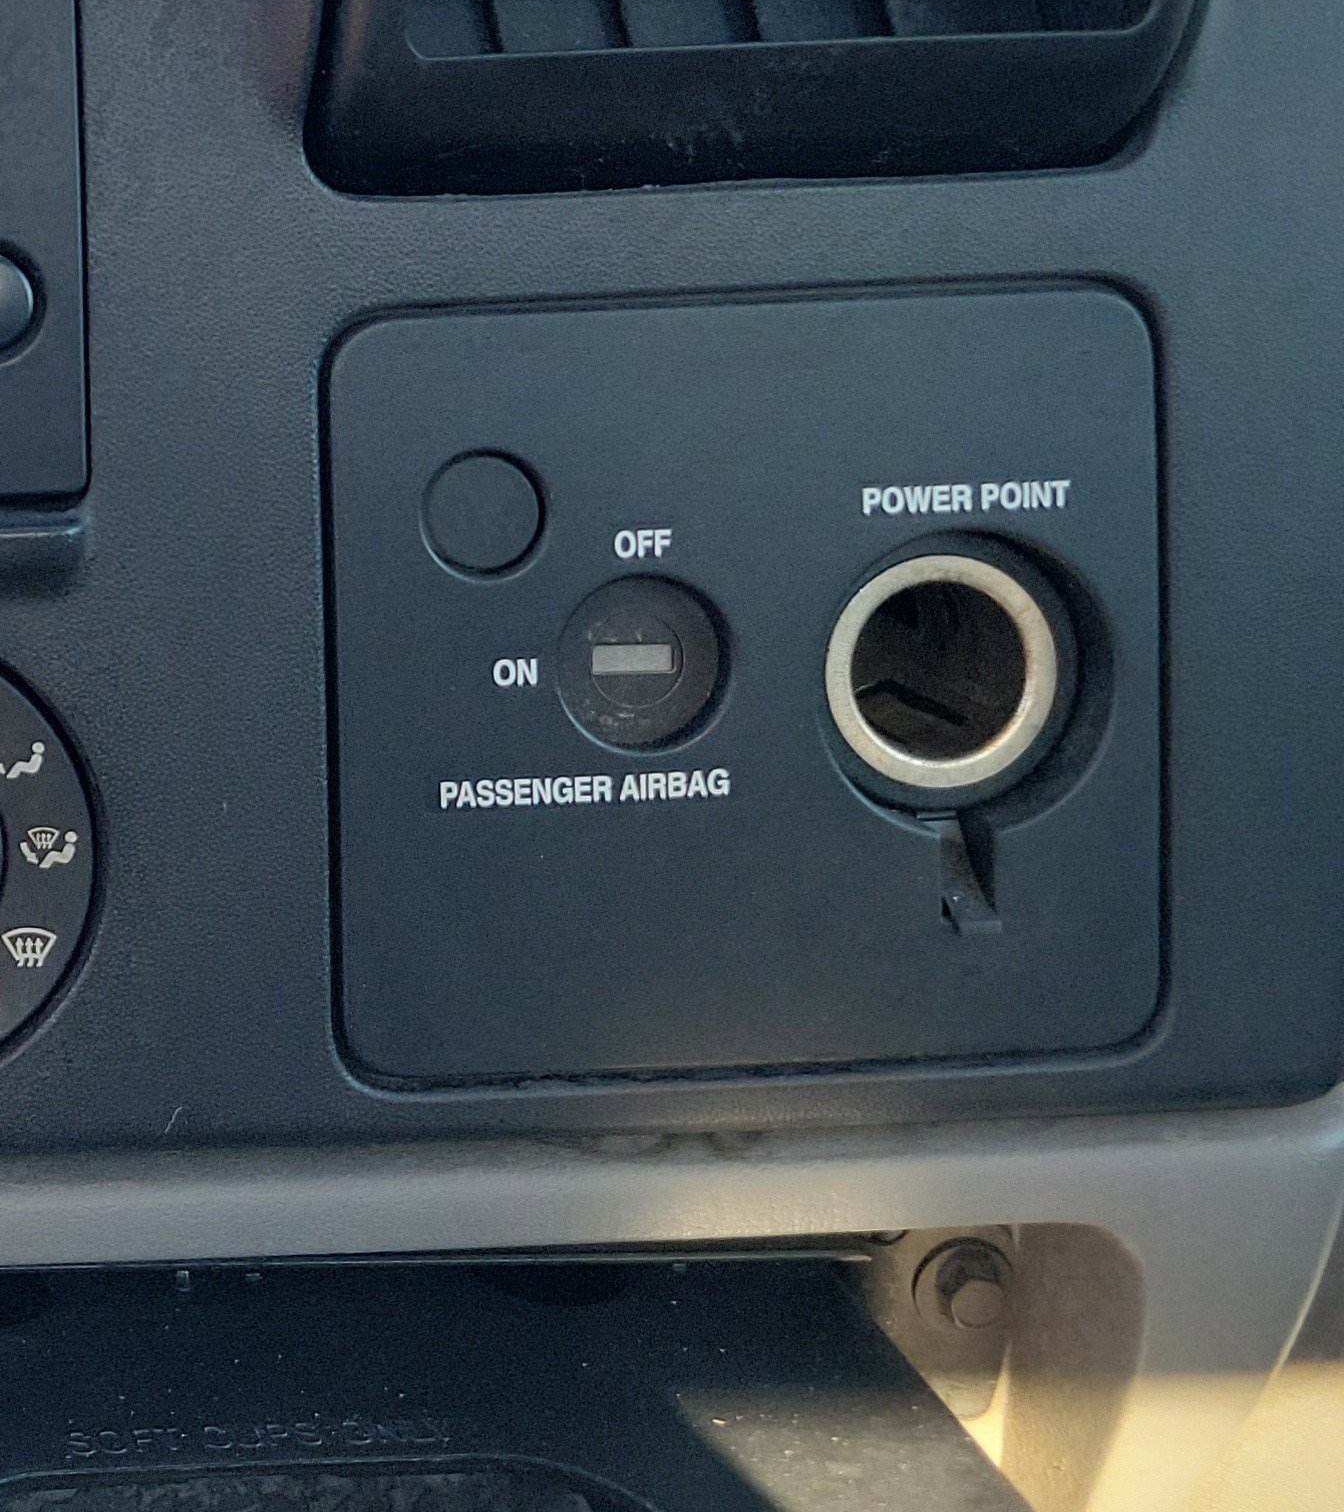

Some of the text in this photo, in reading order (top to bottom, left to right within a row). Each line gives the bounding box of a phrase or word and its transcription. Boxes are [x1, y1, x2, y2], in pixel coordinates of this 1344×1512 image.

[862, 479, 1071, 516] POWER POINT
[614, 528, 672, 559] OFF
[493, 658, 538, 688] ON
[439, 768, 732, 810] PASSENGER AIRBAG
